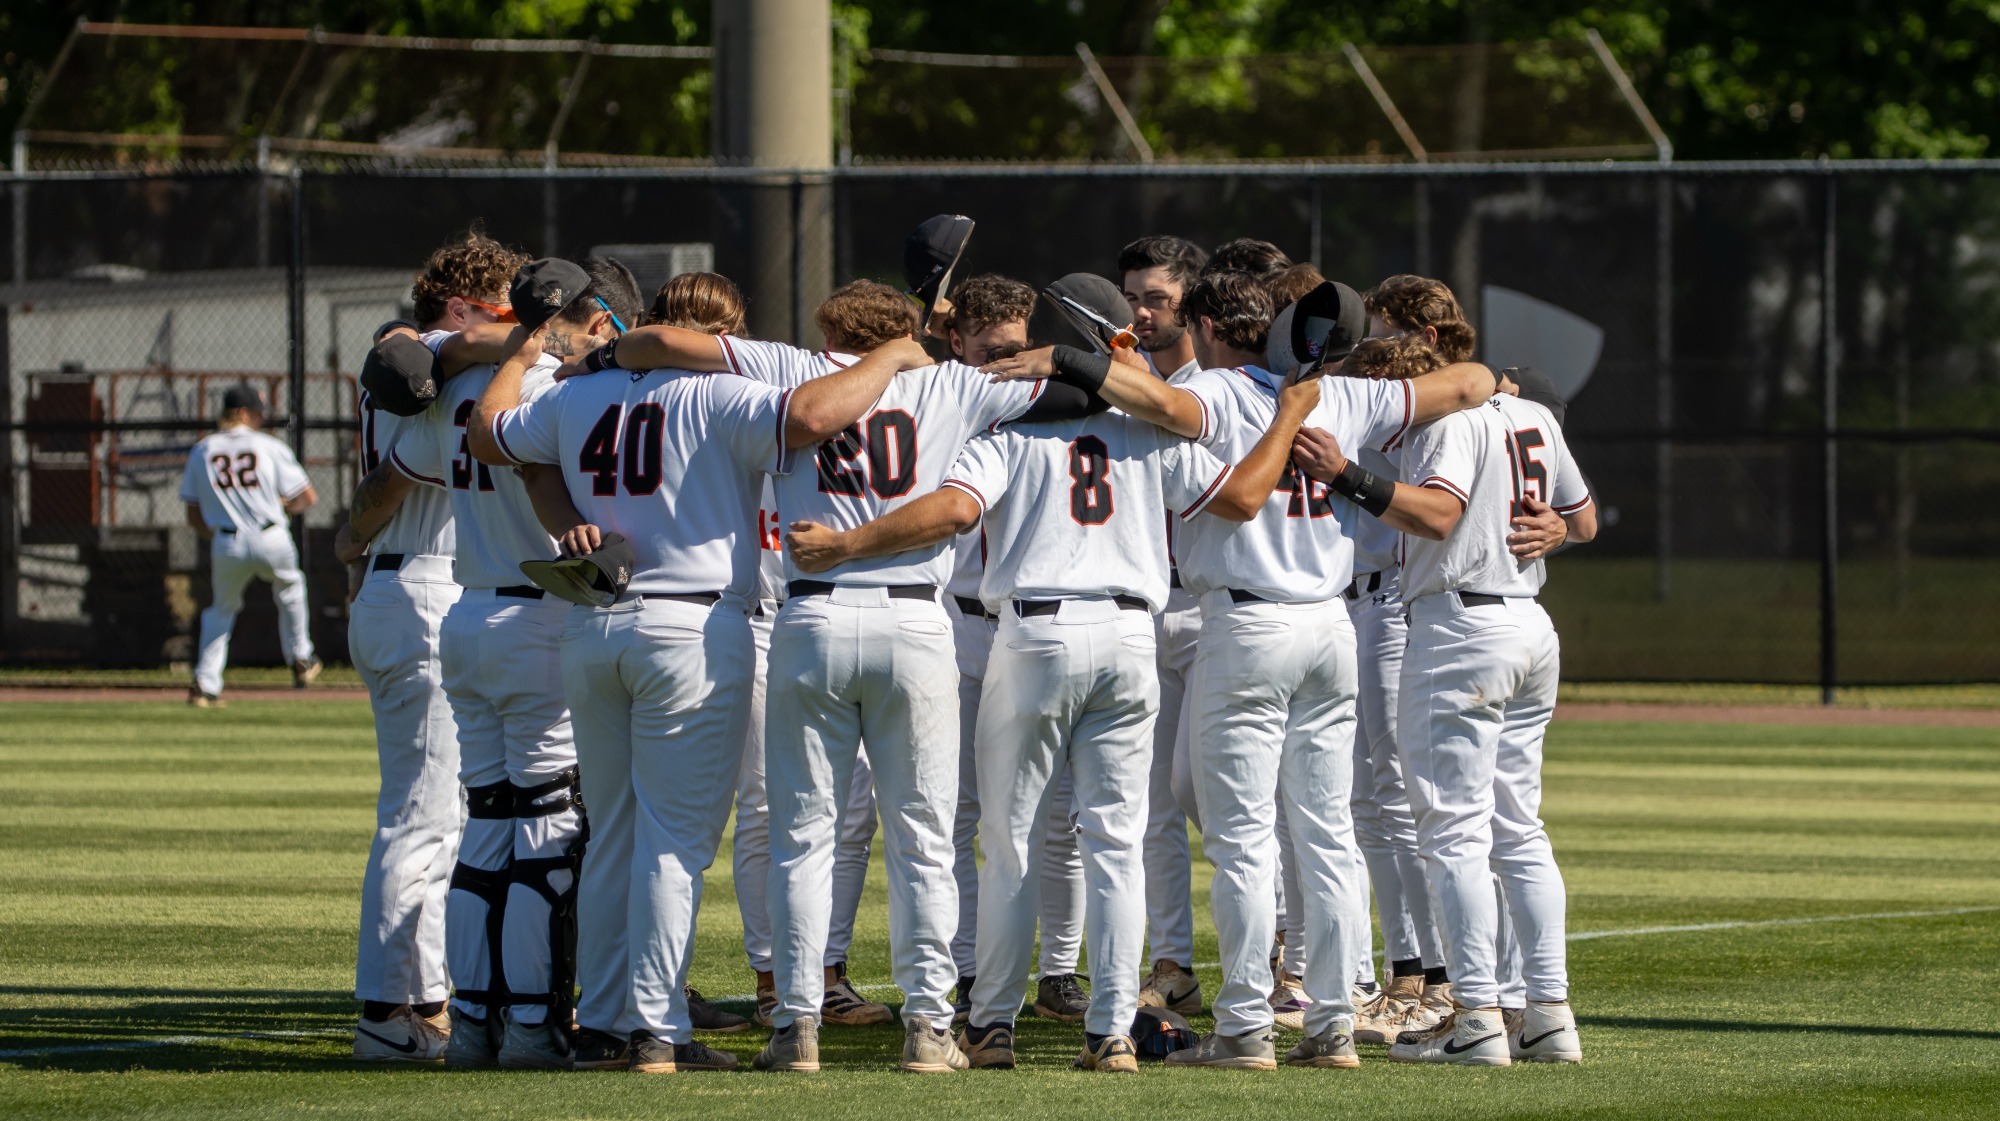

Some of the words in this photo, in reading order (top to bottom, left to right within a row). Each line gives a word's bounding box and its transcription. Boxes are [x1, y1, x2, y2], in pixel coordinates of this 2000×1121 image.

[210, 452, 257, 489] 32
[579, 402, 665, 496] 40
[817, 408, 918, 500] 20
[1068, 434, 1114, 526] 8
[1504, 427, 1547, 523] 15
